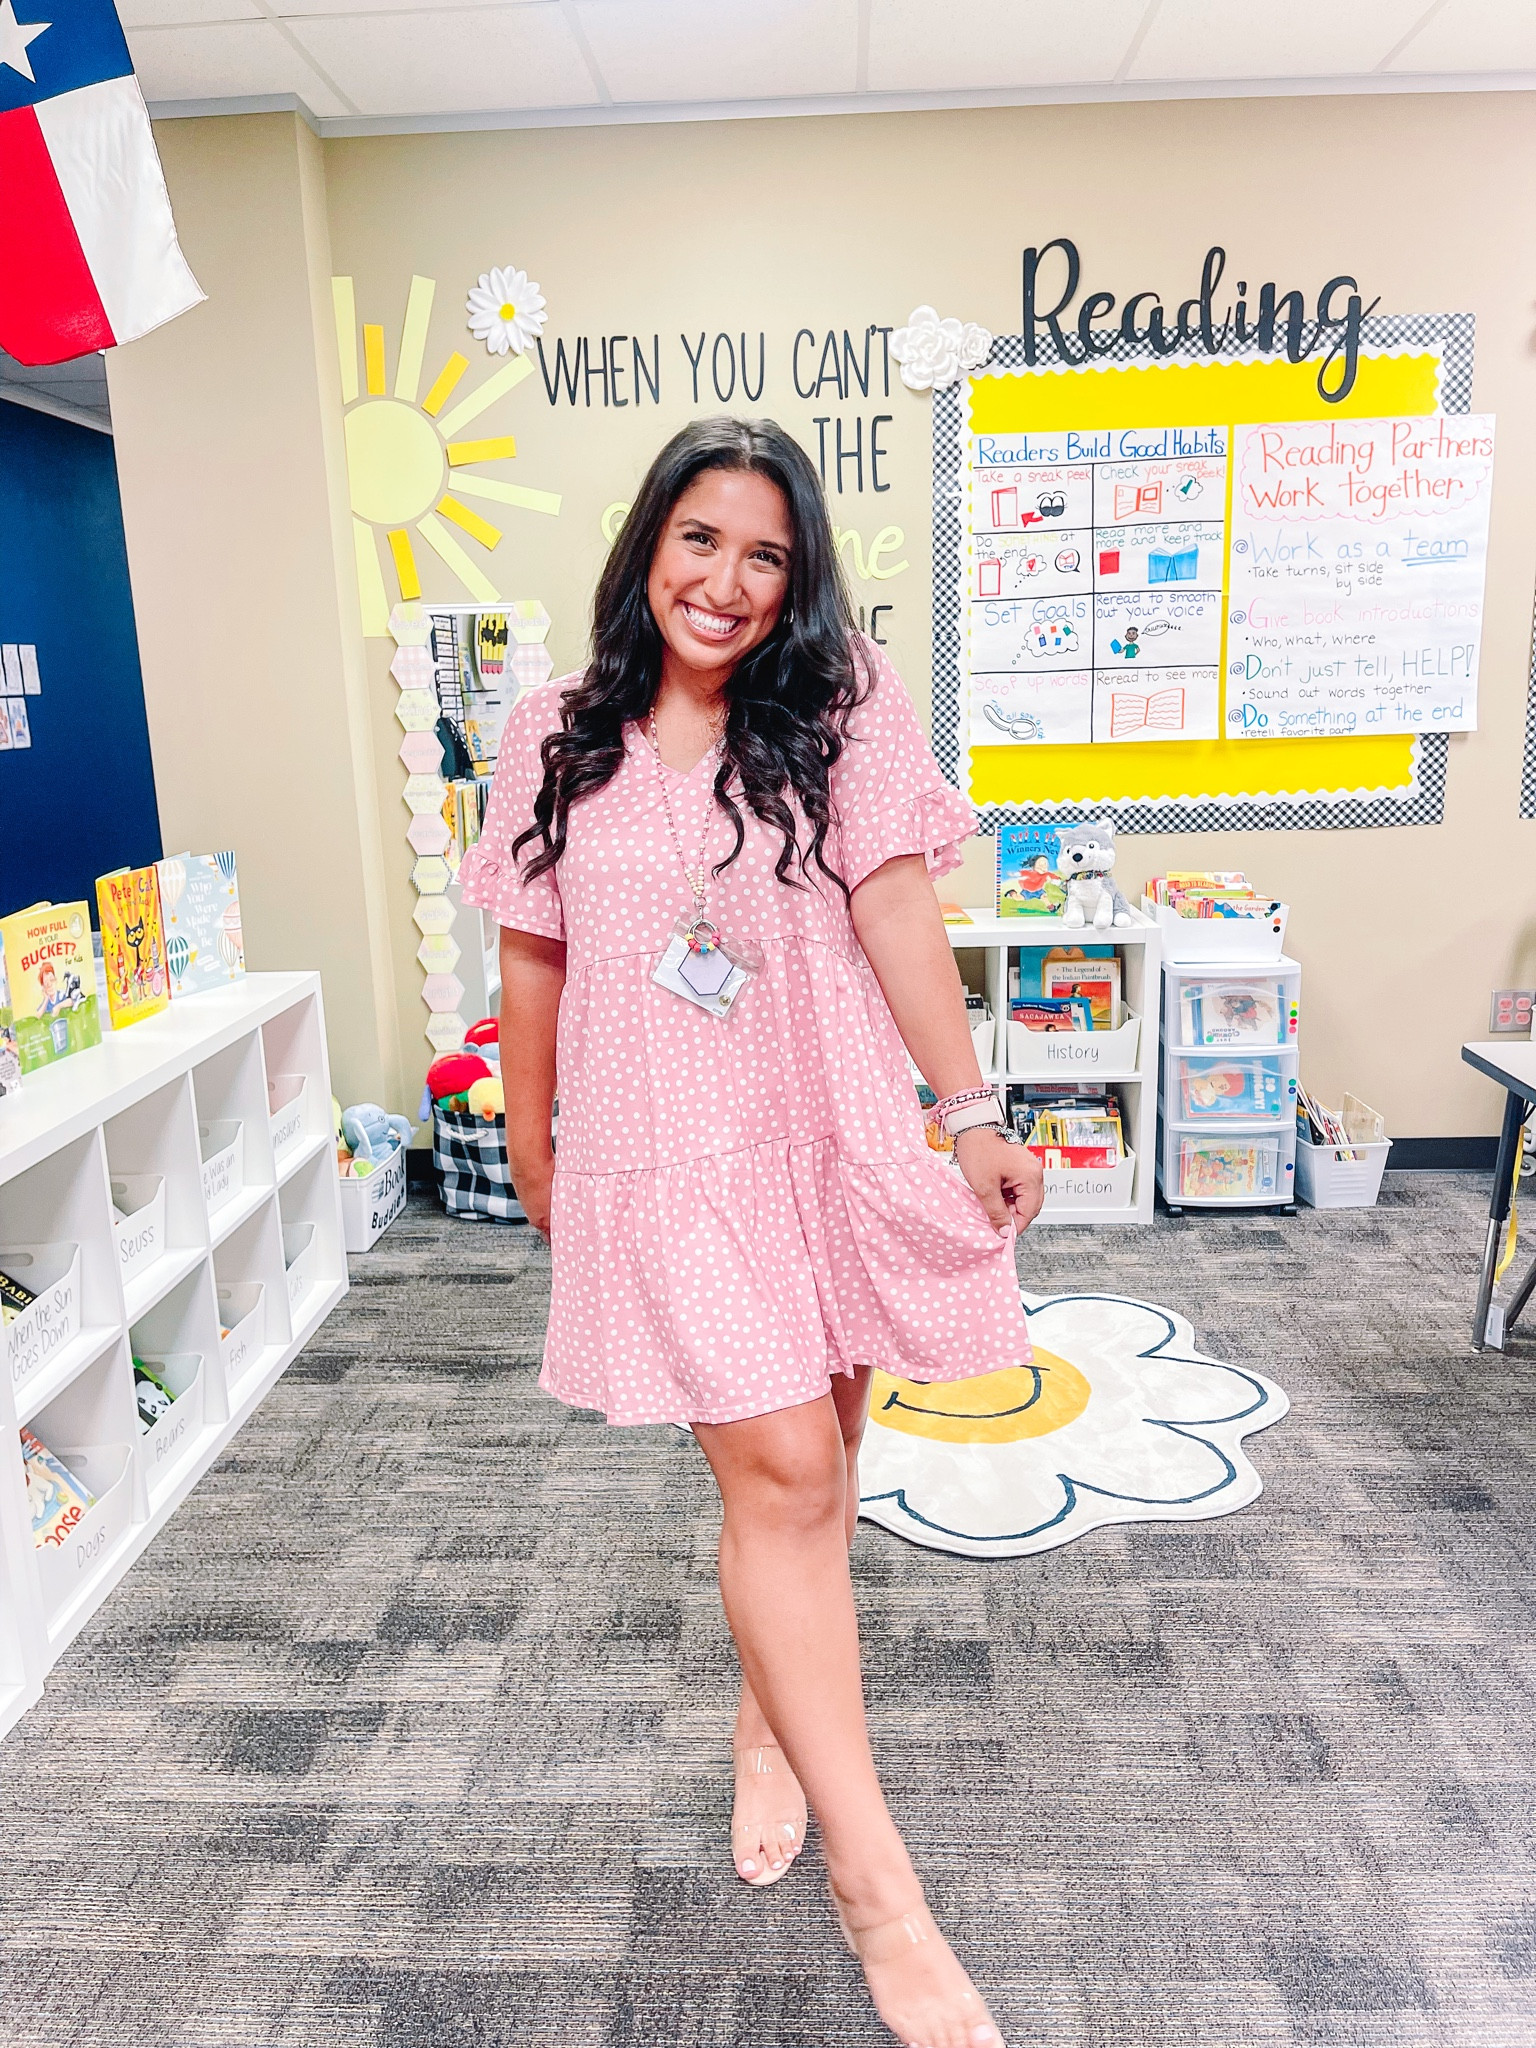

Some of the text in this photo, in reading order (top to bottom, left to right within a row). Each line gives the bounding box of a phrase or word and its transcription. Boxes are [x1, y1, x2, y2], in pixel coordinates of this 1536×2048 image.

[1022, 237, 1381, 404] Reading
[537, 324, 894, 407] WHEN YOU CAN'T
[813, 414, 893, 494] THE
[978, 428, 1226, 464] Readers Build Good Habits
[1261, 418, 1493, 475] Reading Partners
[975, 468, 1091, 487] Take a sneak peek
[1099, 459, 1208, 483] Check your sneak
[1196, 464, 1226, 481] peek!
[1249, 468, 1464, 517] Work together
[976, 535, 993, 548] Do
[1060, 531, 1076, 542] at
[1095, 522, 1203, 540] Read more and
[1095, 531, 1223, 551] more and keep track
[974, 545, 1028, 560] the end
[1249, 528, 1470, 565] Work as a team
[1252, 561, 1384, 579] Take turns, sit side
[1335, 574, 1384, 597] by side
[1096, 592, 1216, 606] Reread to smooth
[984, 597, 1087, 628] Set Goals
[1096, 604, 1205, 622] out your voice
[1248, 597, 1480, 630] Give book introductions
[1253, 632, 1377, 649] Who, what, where
[1246, 643, 1475, 684] Don't just tell, HELP!
[1026, 675, 1045, 692] up
[1050, 673, 1089, 687] words
[1096, 669, 1218, 687] Reread to see more
[1248, 683, 1433, 701] Sound out words together
[1243, 697, 1464, 732] Do Something at the end
[1244, 726, 1355, 738] retell favorite part
[1007, 845, 1042, 856] Winners
[111, 883, 132, 902] Pete
[138, 877, 154, 893] Cat
[27, 920, 68, 939] HOW FULL
[21, 941, 77, 972] BUCKET?
[1073, 966, 1095, 974] Legend
[1047, 1043, 1100, 1063] History
[1073, 1136, 1113, 1146] Giraffes
[1043, 1179, 1113, 1195] on-Fiction
[119, 1224, 155, 1264] Seuss
[34, 1302, 52, 1332] the
[53, 1286, 73, 1314] Sun
[11, 1315, 70, 1383] Goes Down
[229, 1340, 247, 1371] Fish
[154, 1418, 186, 1462] Bears
[76, 1524, 106, 1569] Dogs
